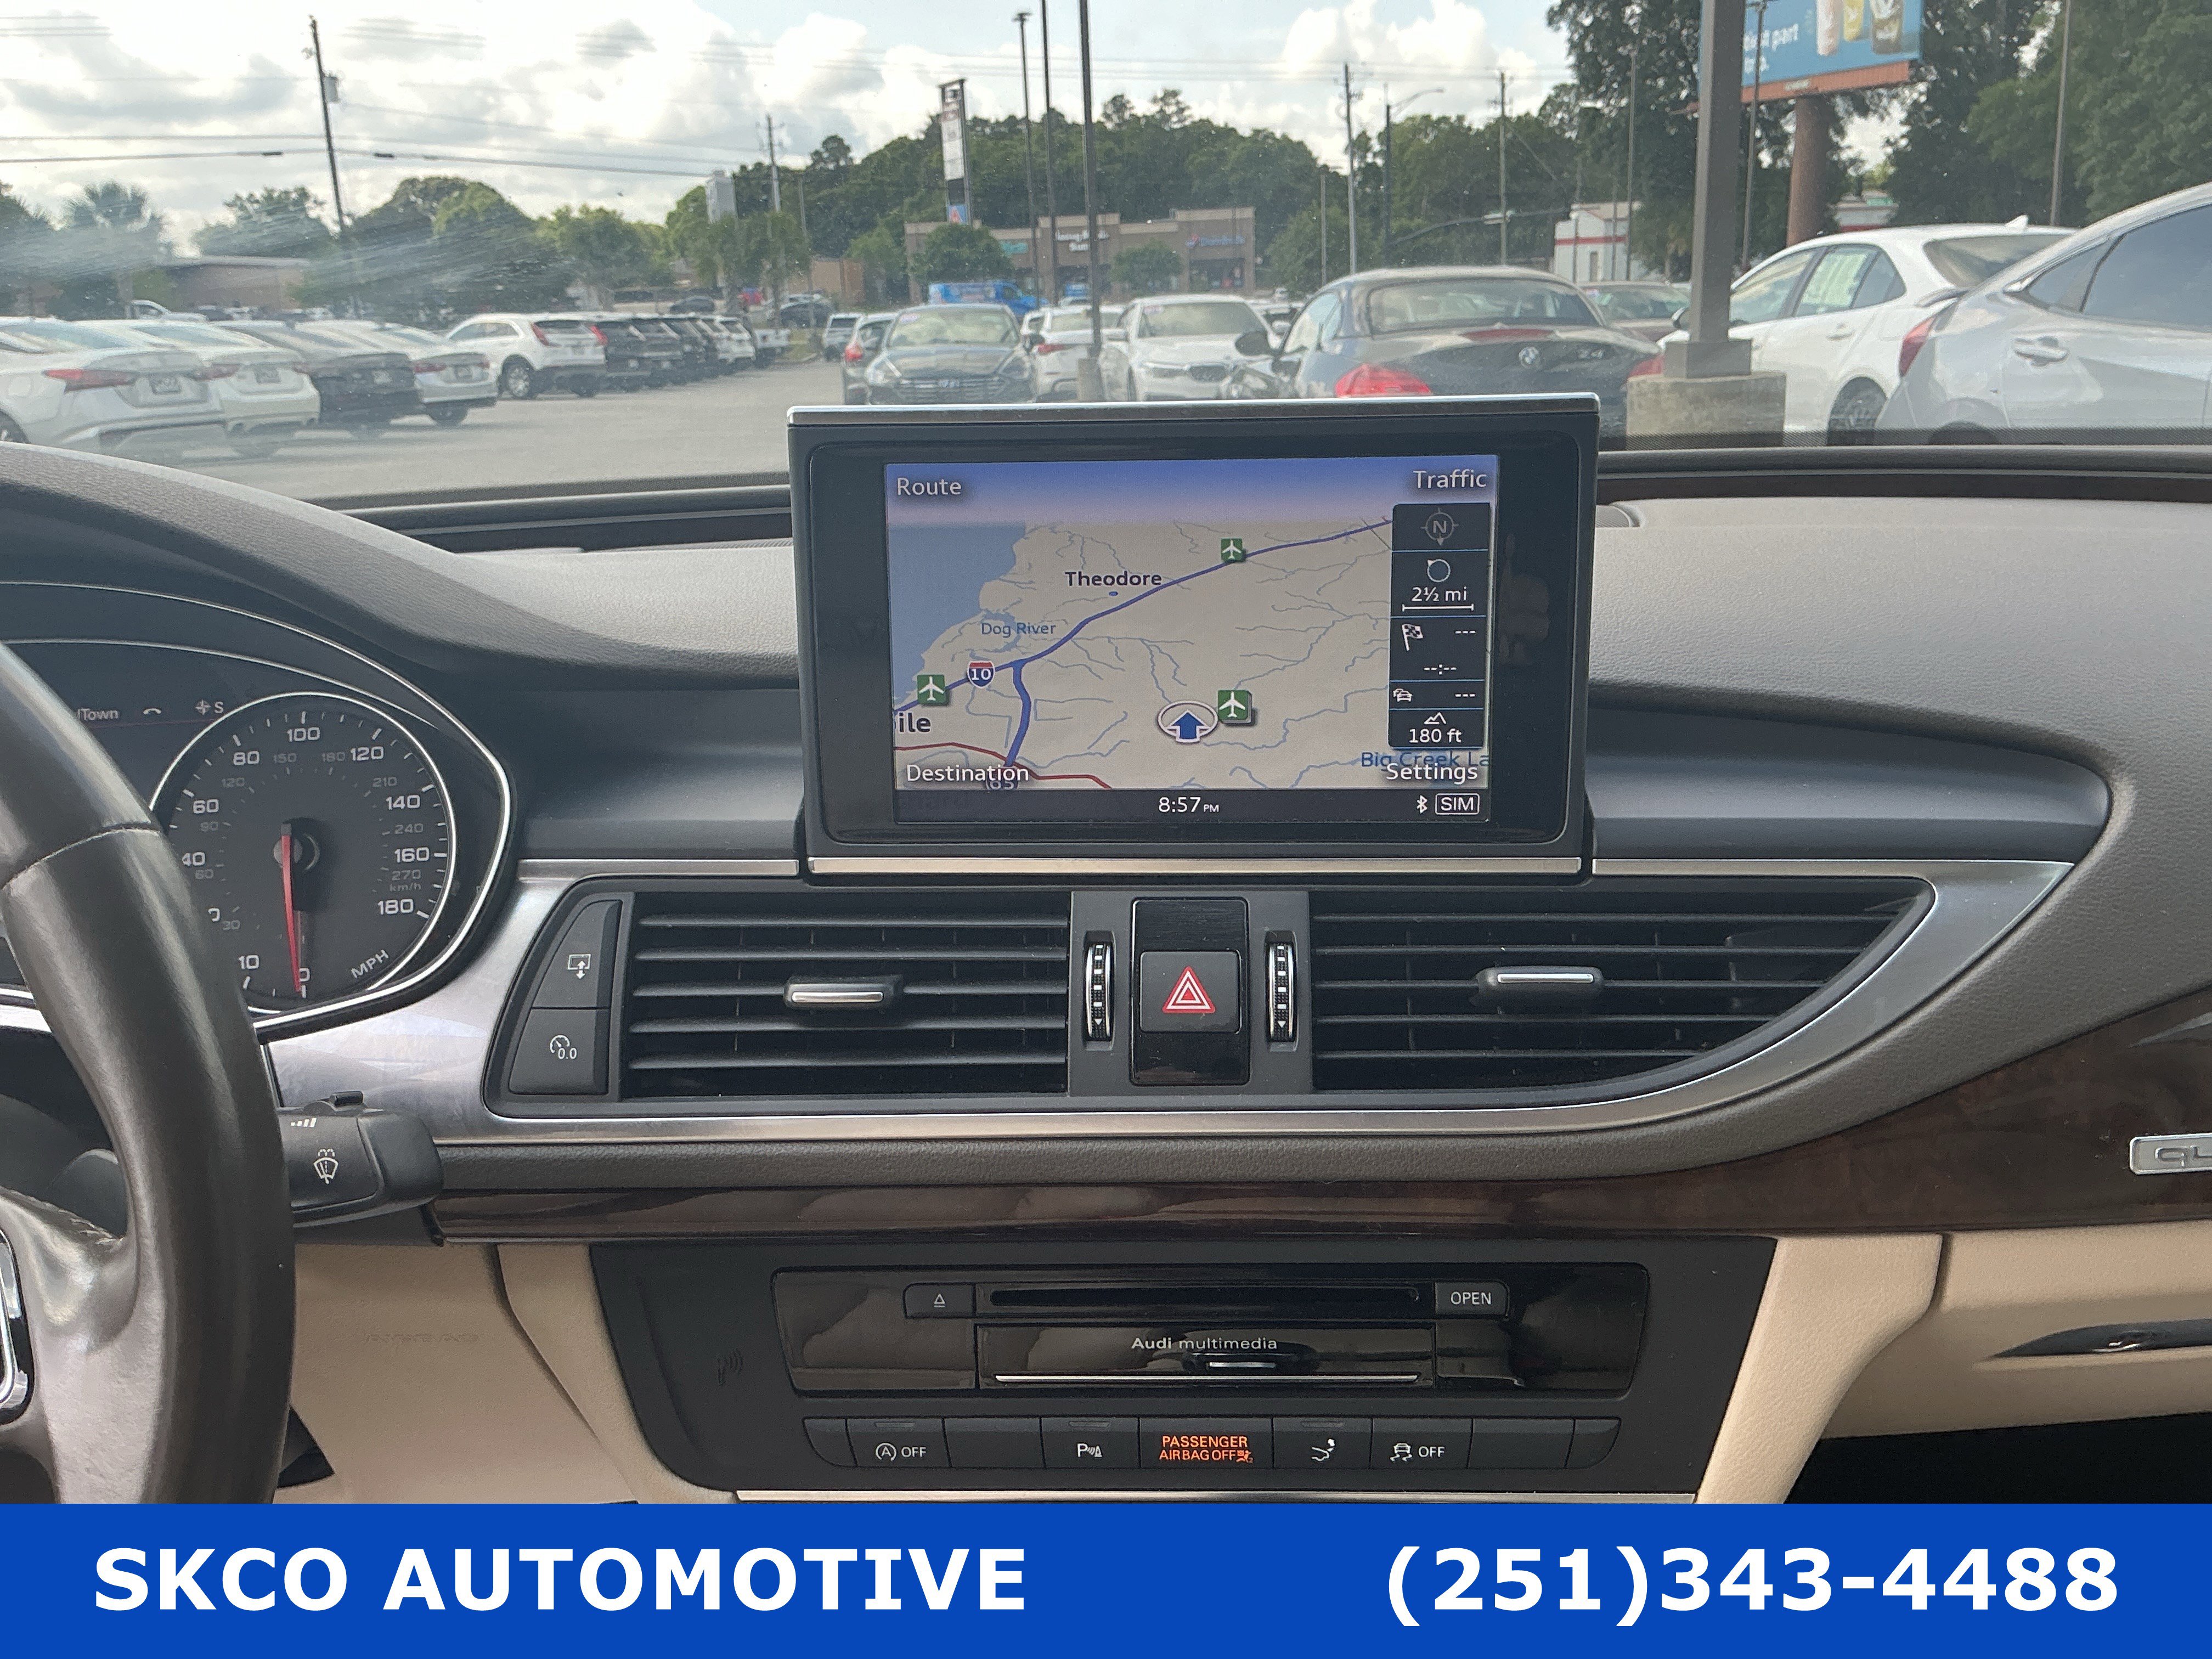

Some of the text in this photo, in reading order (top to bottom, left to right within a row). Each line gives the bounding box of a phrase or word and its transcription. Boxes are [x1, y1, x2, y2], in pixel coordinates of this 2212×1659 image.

[897, 477, 962, 495] Route
[1412, 469, 1487, 489] Traffic
[1432, 520, 1447, 534] N
[1064, 571, 1163, 587] Theodore
[1444, 586, 1468, 602] mi
[981, 622, 1057, 637] Dog River
[970, 668, 991, 681] 10
[214, 701, 224, 714] S
[899, 712, 932, 733] ile
[286, 727, 321, 742] 100
[1409, 728, 1463, 743] 180 ft
[233, 751, 260, 766] 80
[274, 752, 297, 763] 150
[321, 752, 346, 763] 180
[350, 746, 385, 761] 120
[1400, 751, 1460, 767] Creek
[906, 764, 1029, 782] Destination
[1386, 762, 1479, 785] Settings
[221, 777, 245, 788] 120
[373, 776, 397, 787] 210
[193, 799, 219, 814] 60
[385, 794, 421, 810] 140
[1158, 797, 1220, 812] 8:57 PM
[1440, 797, 1475, 811] SIM
[200, 821, 219, 832] 90
[394, 823, 424, 834] 240
[182, 851, 206, 866] 40
[394, 847, 430, 863] 160
[195, 868, 214, 879] 60
[391, 869, 422, 881] 270
[389, 882, 421, 892] km/h
[377, 898, 414, 915] 180
[222, 919, 240, 930] 30
[238, 955, 260, 969] 10
[350, 949, 390, 979] MPH
[298, 967, 311, 982] 0
[557, 1047, 577, 1059] 0.0
[1450, 1291, 1492, 1305] OPEN
[1131, 1336, 1278, 1350] Audi multimedia
[1162, 1435, 1248, 1448] PASSENGER
[901, 1446, 927, 1458] OFF
[1211, 1449, 1236, 1461] OFF
[1418, 1446, 1445, 1458] OFF
